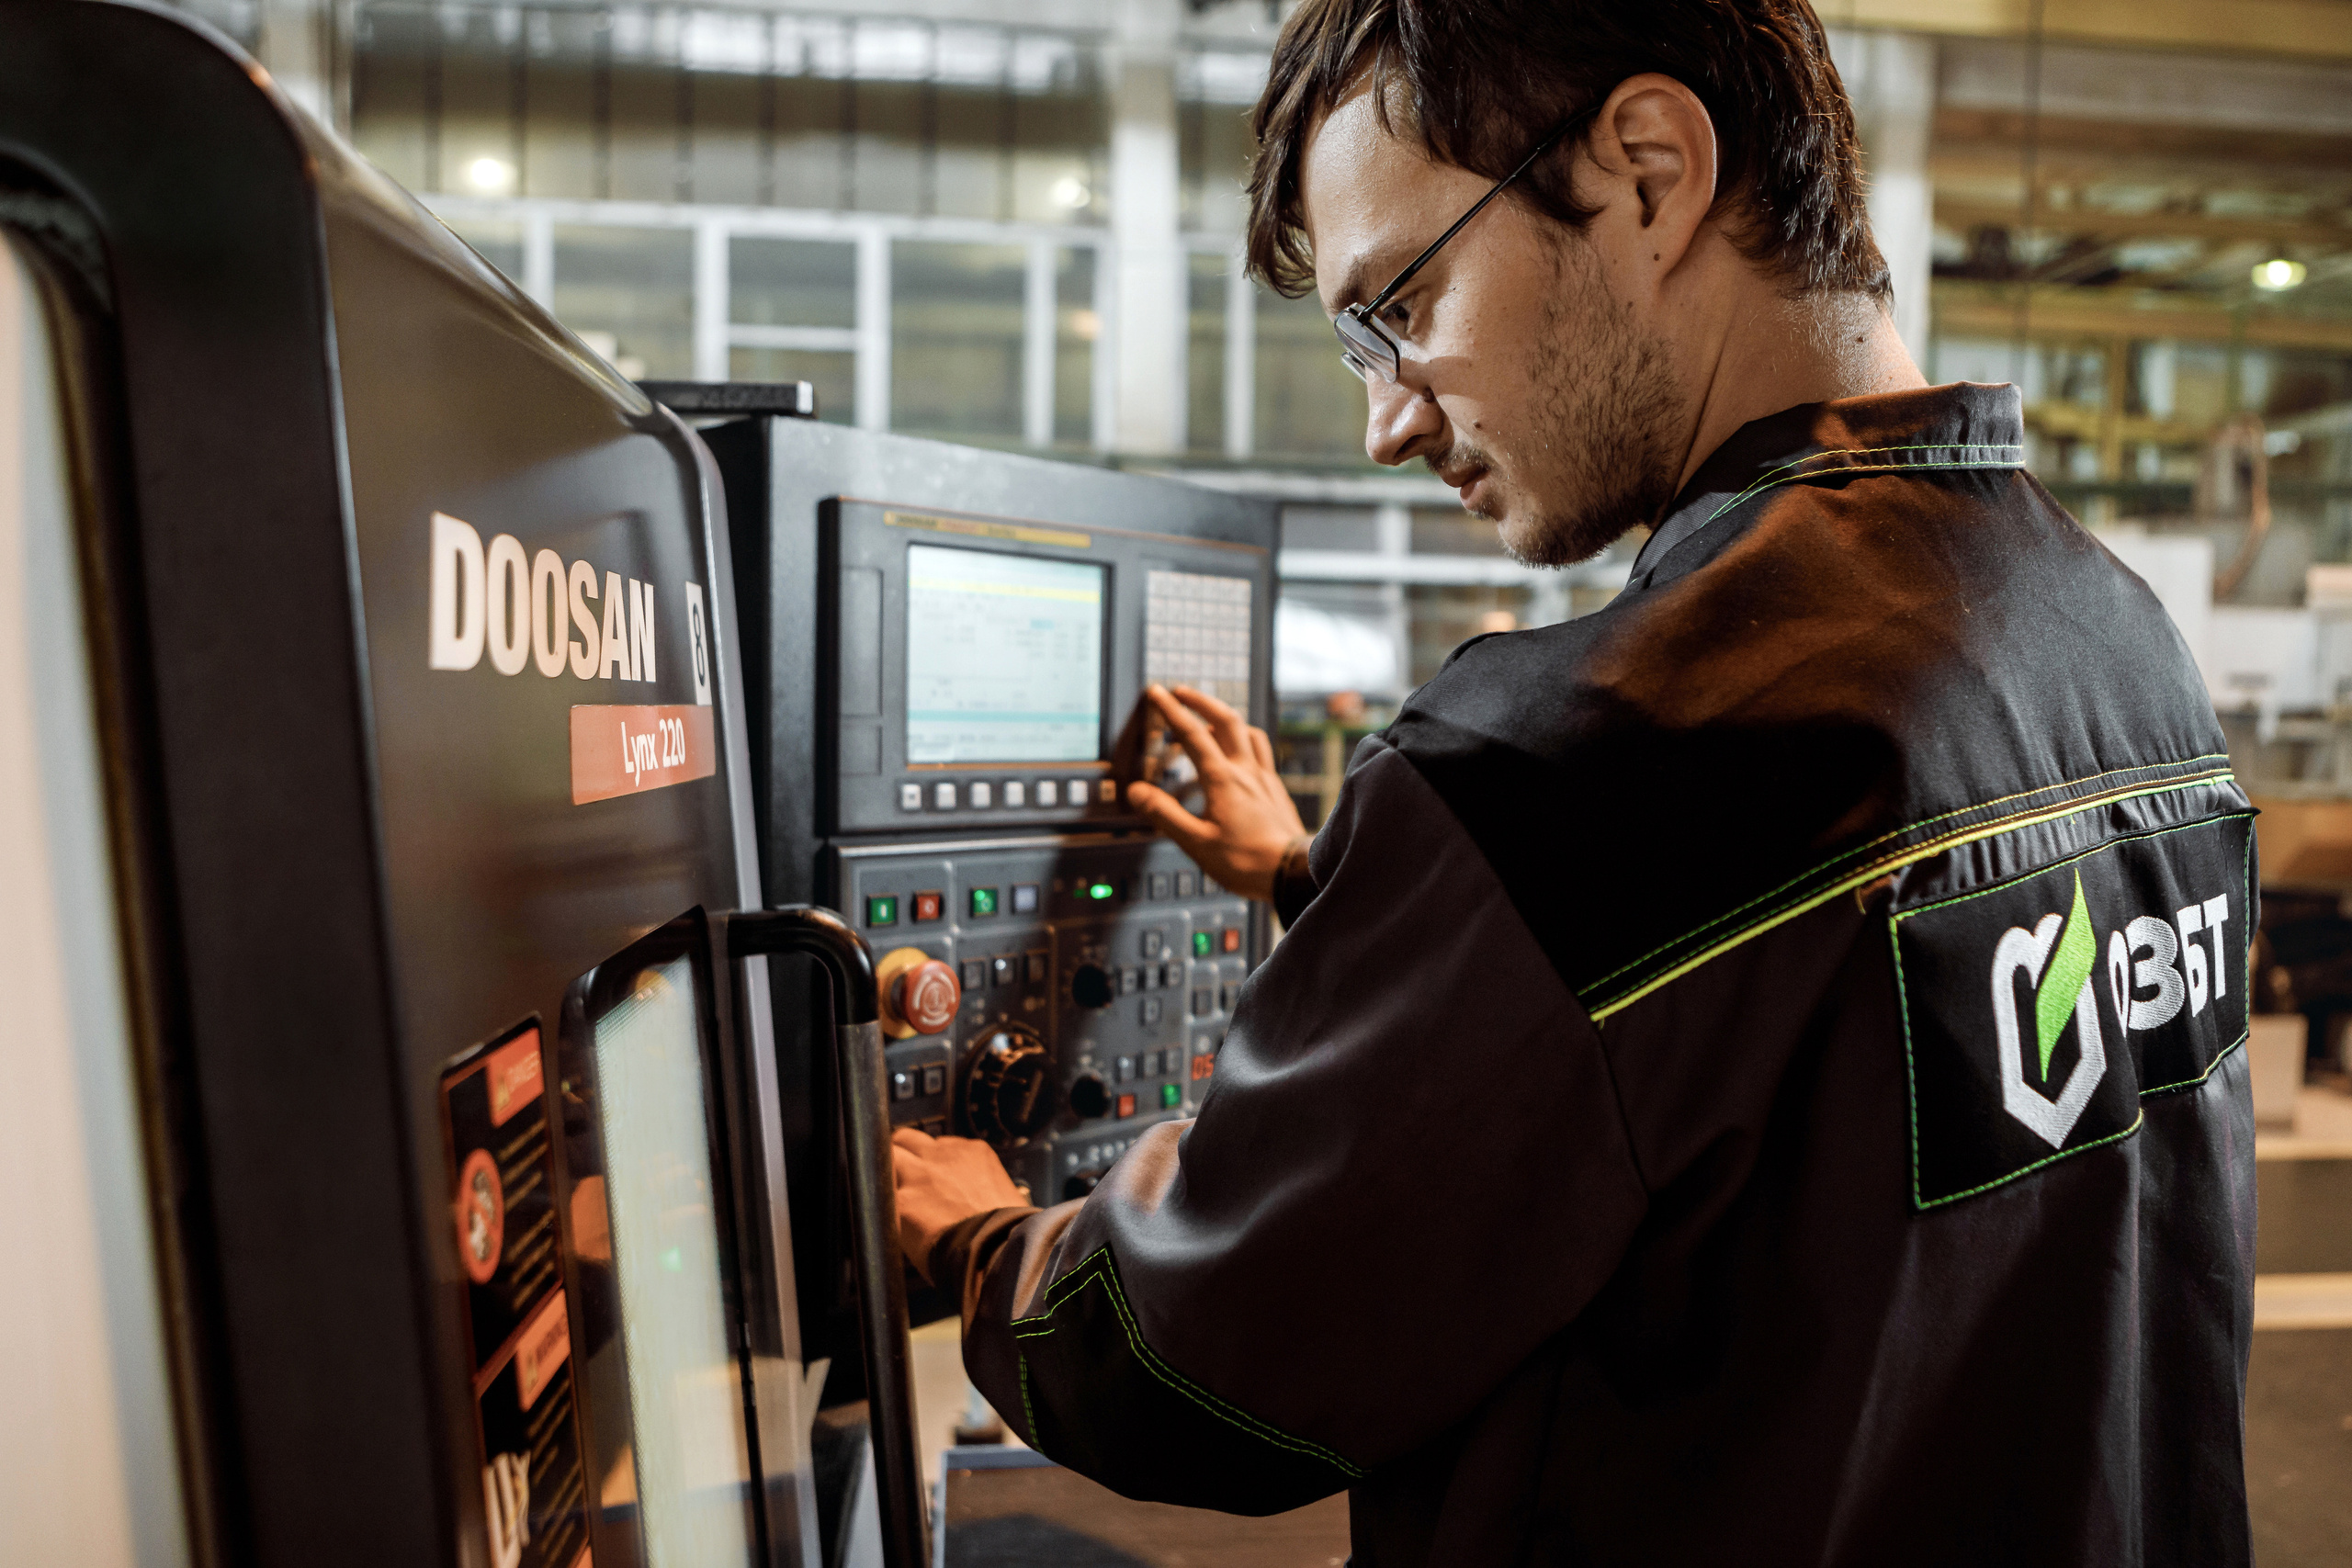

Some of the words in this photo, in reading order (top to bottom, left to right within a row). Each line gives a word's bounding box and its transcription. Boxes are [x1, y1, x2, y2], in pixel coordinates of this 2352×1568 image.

[431, 511, 655, 682] DOOSAN
[621, 721, 658, 787] Lynx
[660, 717, 686, 768] 220
